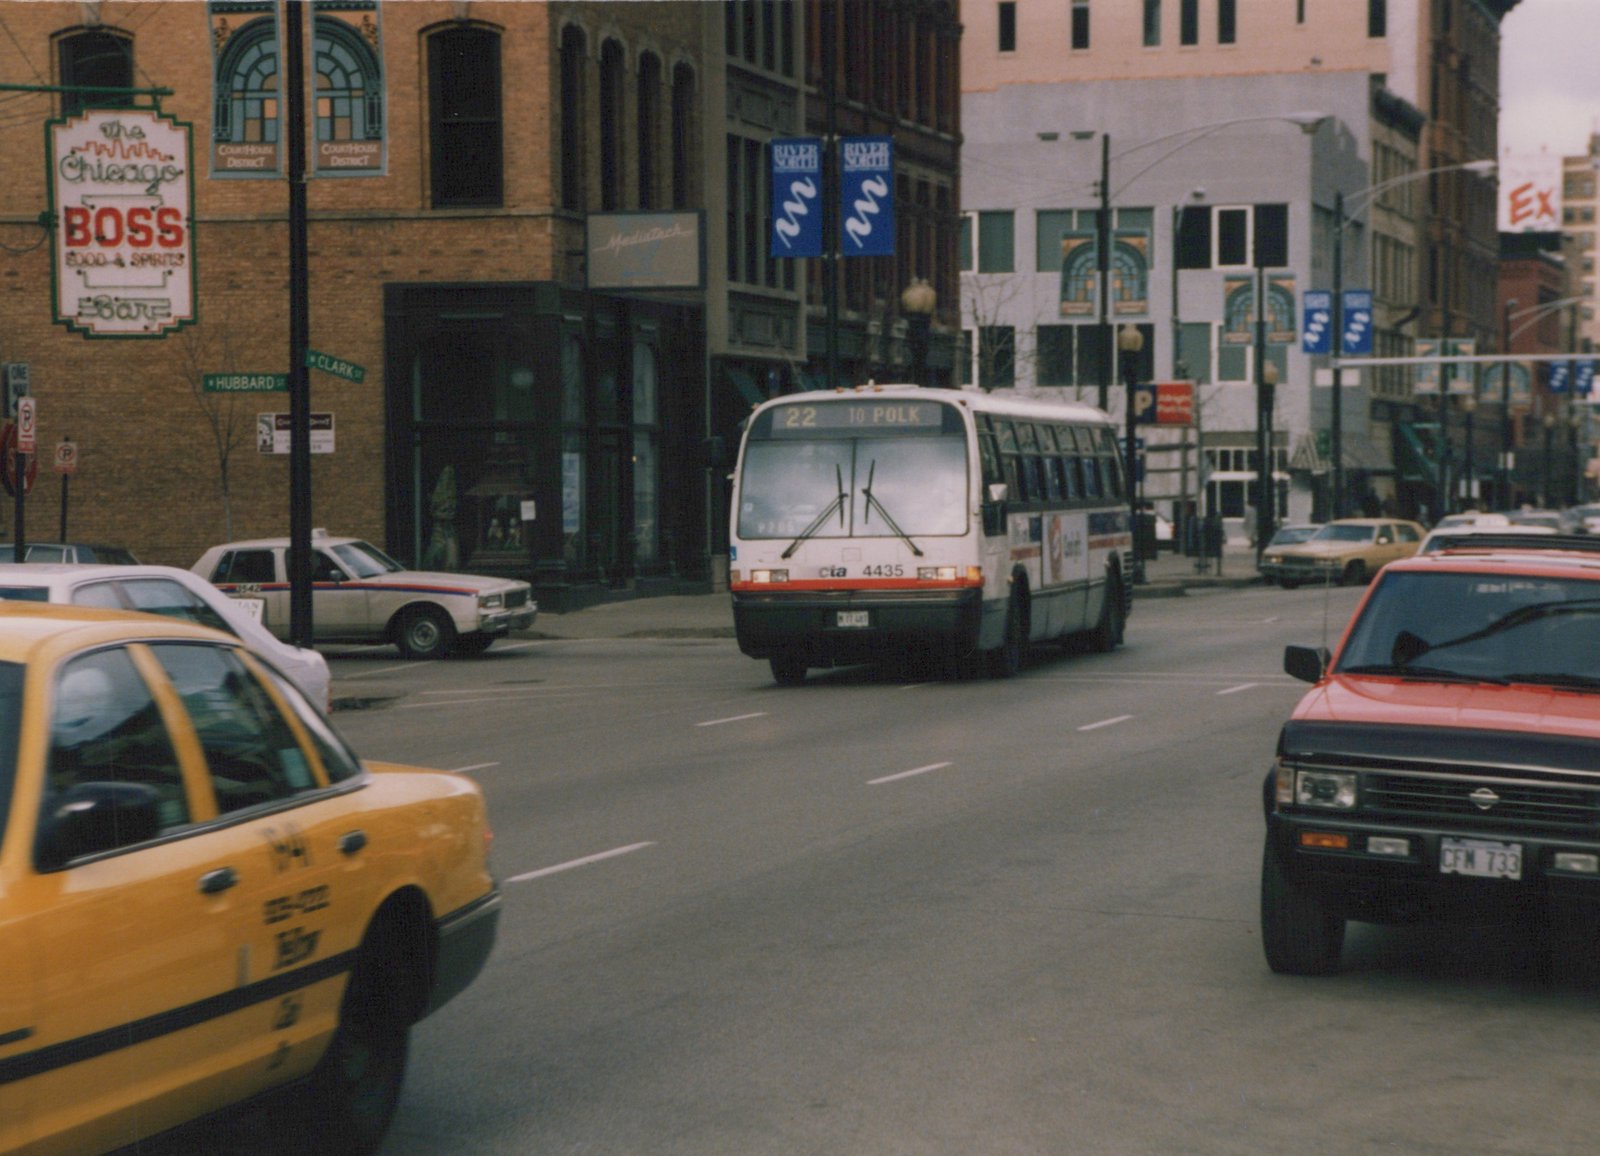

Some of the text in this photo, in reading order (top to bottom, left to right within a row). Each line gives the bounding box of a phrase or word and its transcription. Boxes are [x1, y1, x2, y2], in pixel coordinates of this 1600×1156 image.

[100, 120, 146, 139] The
[773, 144, 818, 156] RIVER
[843, 142, 889, 154] RIVER
[60, 154, 184, 195] Chicago
[64, 206, 184, 248] BOSS
[65, 252, 107, 267] FOOD
[130, 252, 184, 267] SPIRITS
[92, 294, 156, 322] Bar
[11, 366, 29, 379] ONE
[317, 355, 354, 379] CLARK
[216, 376, 274, 390] HUBBARD
[1135, 391, 1153, 416] P
[785, 407, 817, 428] 22
[873, 406, 921, 423] POLK
[818, 564, 904, 578] cta 4435
[1486, 851, 1520, 873] 733
